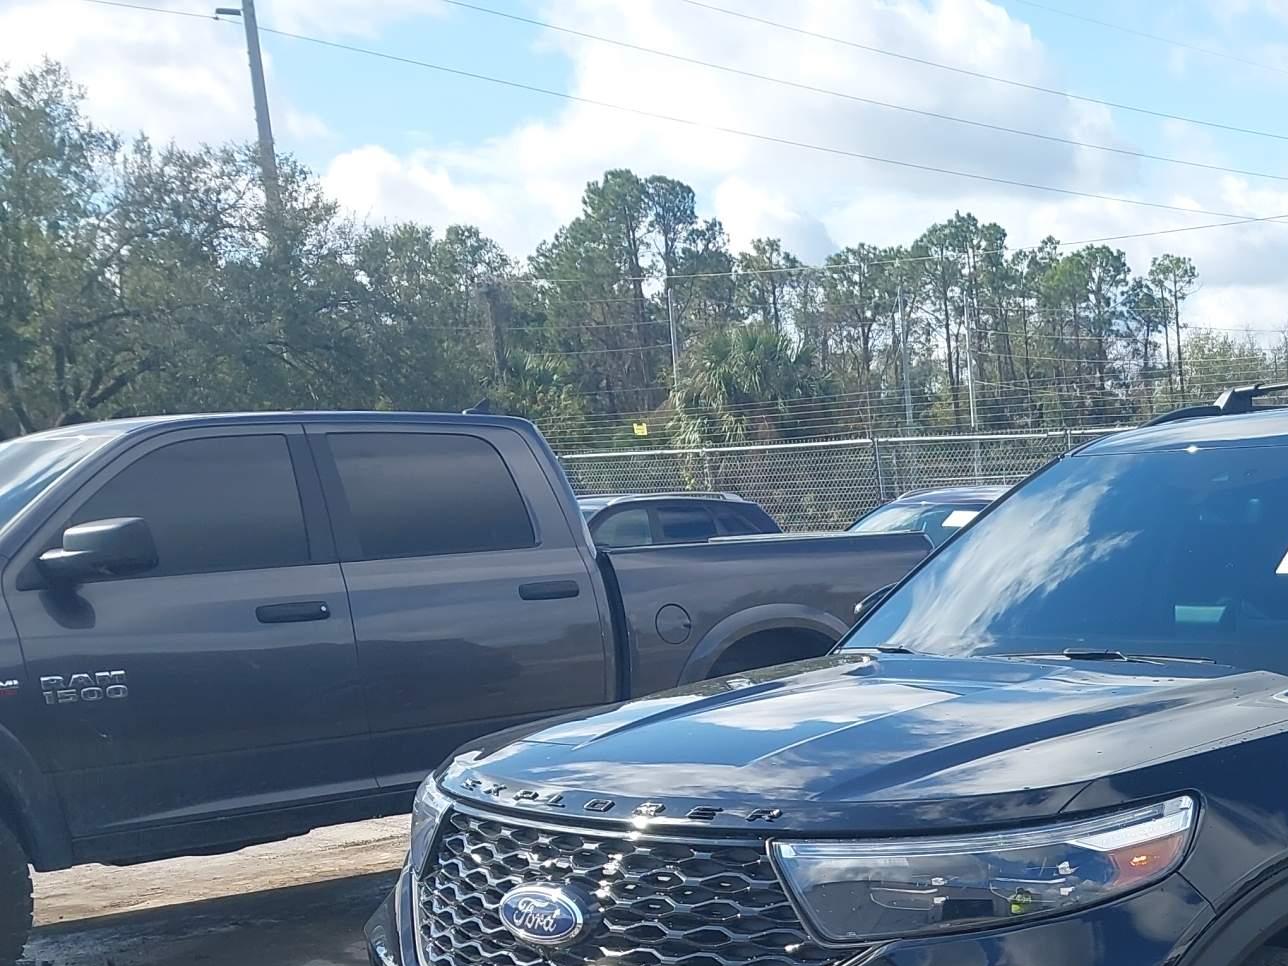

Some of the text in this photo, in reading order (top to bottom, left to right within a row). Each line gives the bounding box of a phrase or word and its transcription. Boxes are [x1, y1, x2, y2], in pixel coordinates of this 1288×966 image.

[40, 670, 125, 690] RAM
[43, 685, 129, 704] 1500
[460, 777, 784, 823] EXPLORER
[513, 897, 561, 932] Ford
